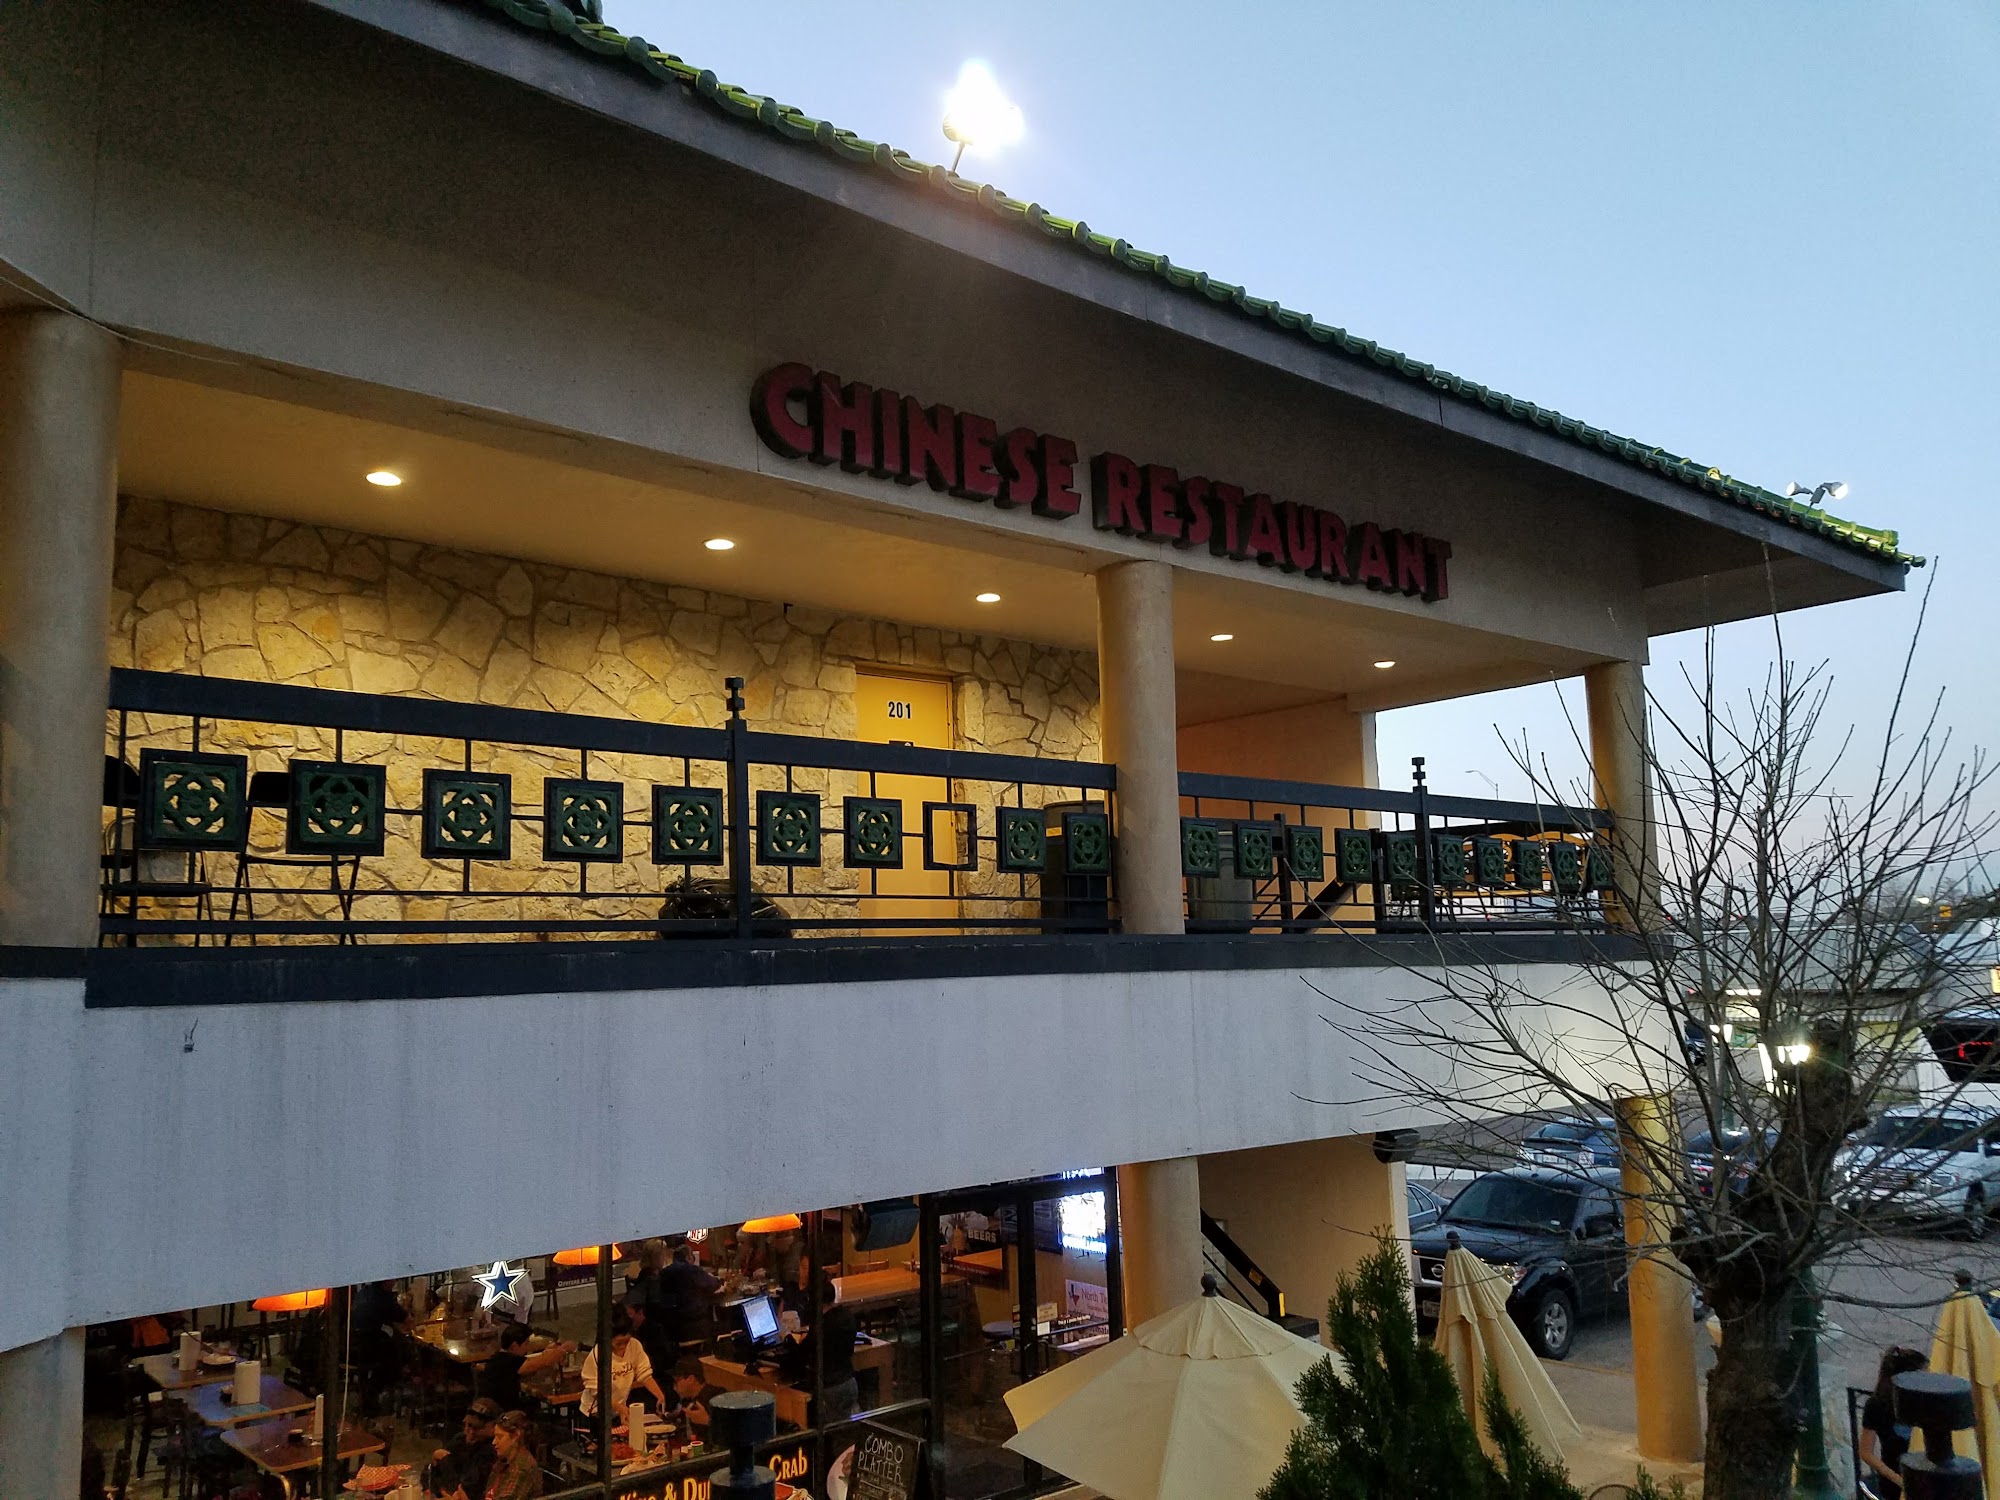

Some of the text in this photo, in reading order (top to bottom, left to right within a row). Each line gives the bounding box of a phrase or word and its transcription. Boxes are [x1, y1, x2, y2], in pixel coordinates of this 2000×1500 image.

[751, 362, 1453, 602] CHINESE RESTAURANT
[888, 701, 911, 719] 201
[968, 1229, 997, 1244] BEERS
[864, 1432, 904, 1464] COMBO
[857, 1451, 904, 1487] PLATTER
